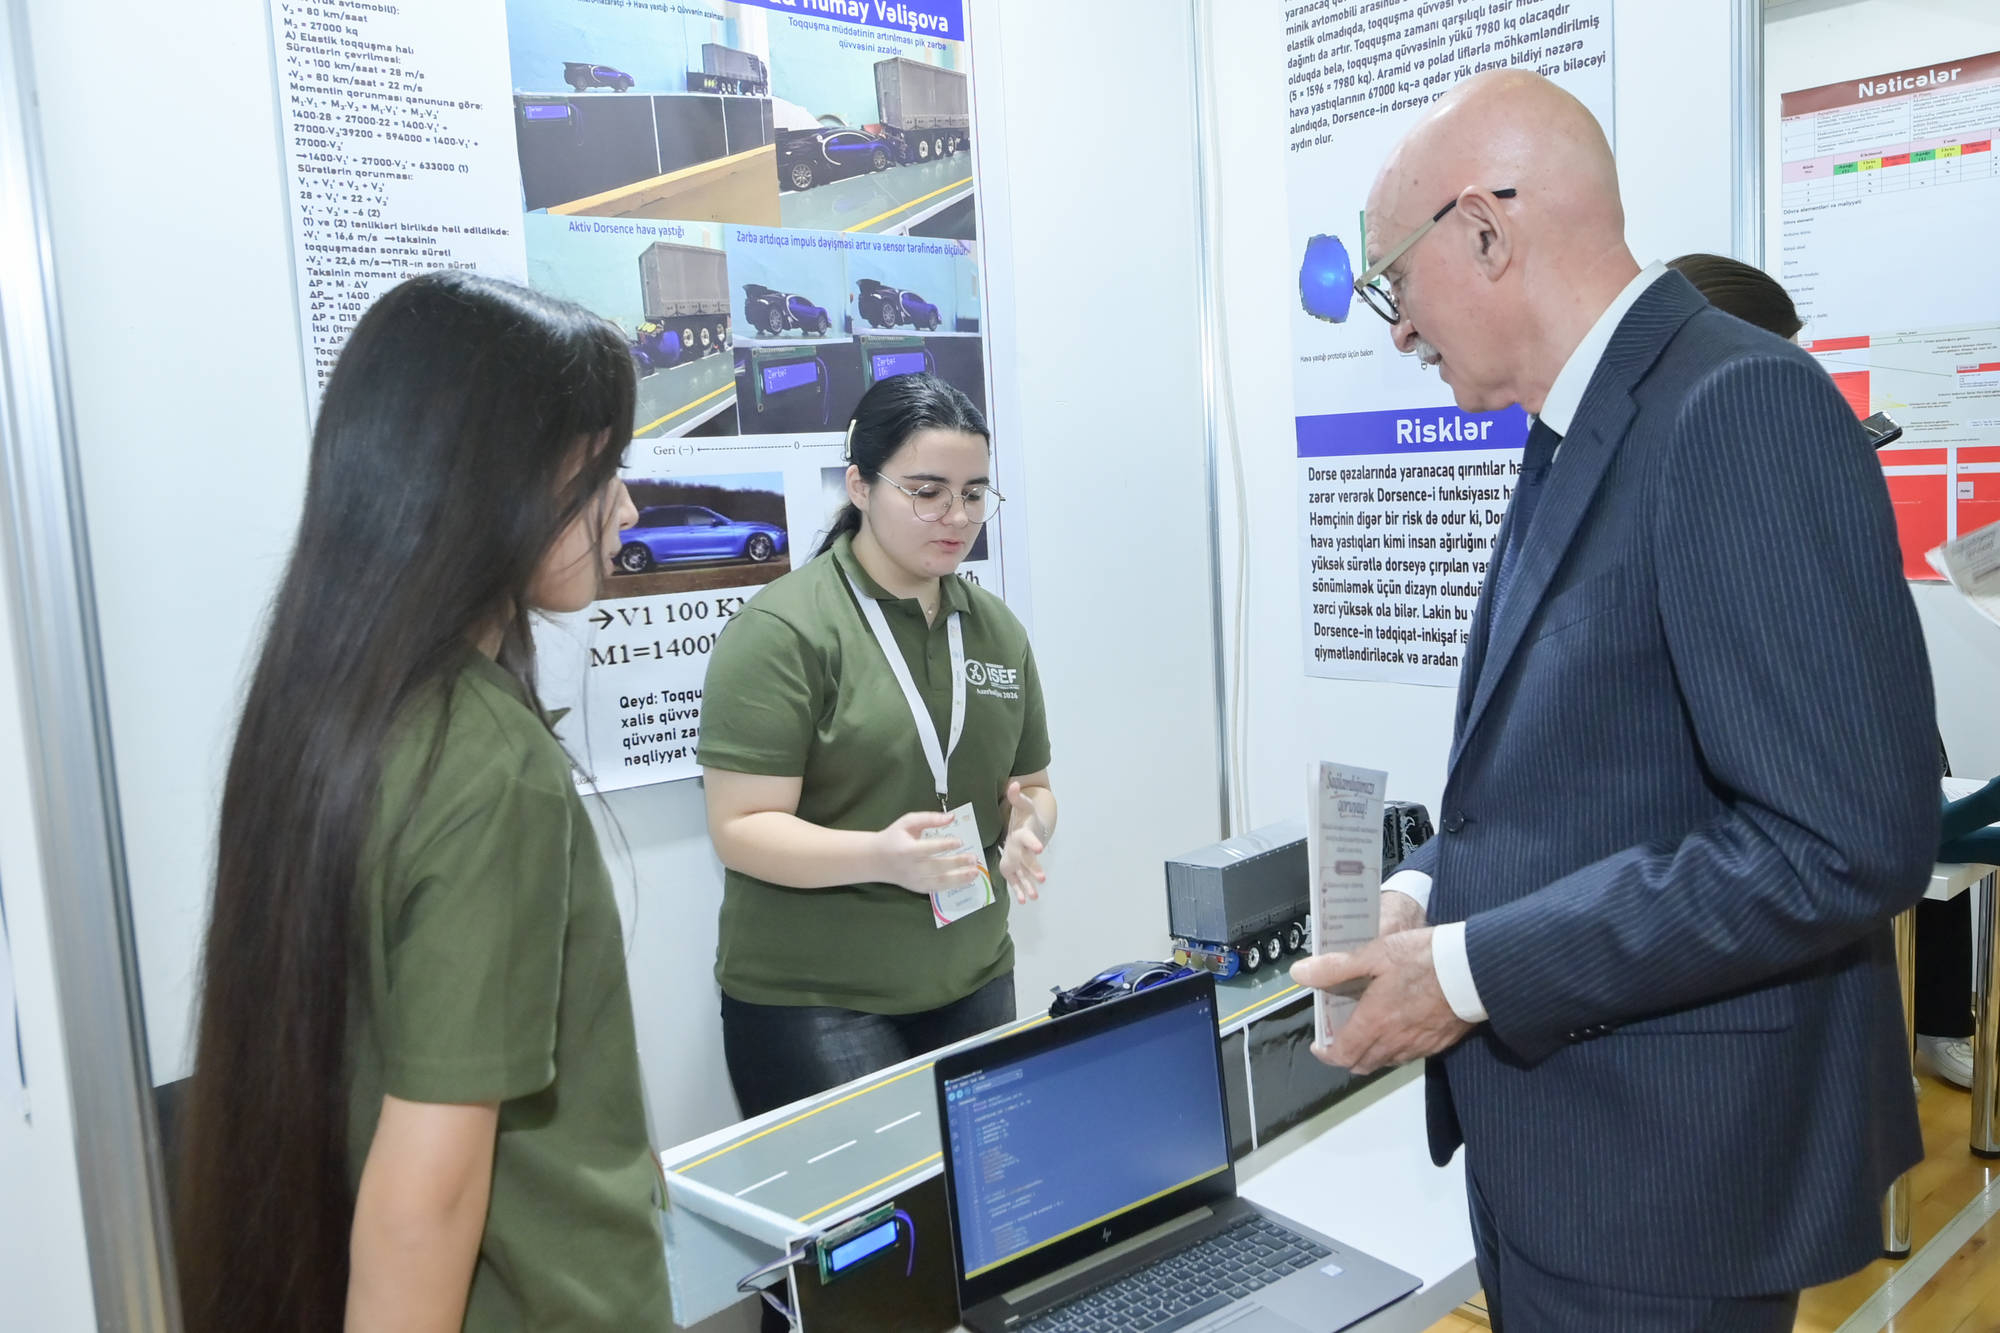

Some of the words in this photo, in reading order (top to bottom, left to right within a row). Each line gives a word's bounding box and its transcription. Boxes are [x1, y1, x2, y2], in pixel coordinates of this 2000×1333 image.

[873, 0, 948, 32] Vəlişova
[1286, 20, 1309, 36] minik
[1312, 5, 1357, 28] avtomobili
[1287, 35, 1315, 52] elastik
[1317, 22, 1366, 43] olmadıqda,
[1368, 9, 1414, 29] toqquşma
[1288, 53, 1315, 69] dağıntı
[1318, 49, 1328, 60] da
[1331, 44, 1352, 56] artır.
[1354, 31, 1401, 50] Toqquşma
[1404, 20, 1438, 37] zamanı
[1442, 6, 1485, 30] qarşılıqlı
[1488, 0, 1512, 15] təsir
[1288, 68, 1321, 85] olduqda
[1324, 62, 1344, 76] belə,
[1347, 51, 1392, 70] toqquşma
[1395, 36, 1446, 60] qüvvəsinin
[1449, 29, 1472, 47] yükü
[1476, 20, 1500, 36] 7980
[1504, 18, 1516, 30] kq
[1519, 4, 1570, 25] olacaqdır
[1334, 75, 1355, 90] 7980
[1358, 70, 1374, 85] kq).
[1377, 61, 1411, 80] Aramid
[1414, 60, 1424, 70] və
[1428, 50, 1454, 70] polad
[1564, 51, 1606, 72] biləcəyi
[1290, 106, 1309, 118] hava
[1311, 93, 1365, 116] yastıqlarının
[1368, 82, 1395, 99] 67000
[1398, 80, 1420, 93] kq-a
[1423, 72, 1451, 88] qədər
[1454, 64, 1472, 82] yük
[1511, 47, 1542, 65] bildiyi
[1546, 40, 1583, 57] nəzərə
[1858, 67, 1962, 99] Nəticələr
[1290, 117, 1330, 135] alındıqda,
[1332, 103, 1388, 124] Dorsence-in
[1392, 96, 1428, 111] dorseyə
[1291, 138, 1312, 153] aydın
[1315, 134, 1333, 145] olur.
[873, 242, 882, 251] və
[1396, 418, 1494, 444] Risklər
[654, 446, 676, 455] Geri
[1308, 467, 1337, 481] Dorse
[1340, 464, 1396, 483] qəzalarında
[1400, 466, 1454, 482] yaranacaq
[1458, 460, 1506, 480] qırıntılar
[1309, 492, 1335, 503] zərər
[1338, 488, 1374, 503] verərək
[1378, 486, 1435, 502] Dorsence-i
[1439, 485, 1500, 504] funksiyasız
[1310, 511, 1354, 529] Həmçinin
[1357, 511, 1382, 529] digər
[1385, 511, 1399, 525] bir
[1402, 510, 1422, 525] risk
[1426, 510, 1438, 525] də
[1442, 510, 1466, 525] odur
[1470, 510, 1482, 527] ki,
[1310, 534, 1333, 548] hava
[1336, 534, 1380, 552] yastıqları
[1384, 534, 1405, 548] kimi
[1408, 534, 1436, 548] insan
[1440, 532, 1486, 553] ağırlığını
[1312, 556, 1344, 574] yüksək
[1347, 556, 1382, 571] sürətlə
[1385, 557, 1426, 576] dorseyə
[1429, 558, 1469, 576] çırpılan
[1312, 578, 1374, 594] sönümləmək
[1377, 579, 1401, 598] üçün
[1405, 580, 1437, 599] dizayn
[618, 606, 653, 626] V1
[666, 601, 708, 623] 100
[1313, 601, 1336, 614] xərci
[1338, 601, 1373, 619] yüksək
[1376, 602, 1391, 617] ola
[1394, 603, 1419, 618] bilər.
[1422, 604, 1451, 619] Lakin
[1454, 606, 1468, 620] bu
[1314, 622, 1373, 639] Dorsence-in
[1376, 626, 1457, 646] tədqiqat-inkişaf
[1315, 645, 1404, 663] qiymətləndiriləcək
[1407, 653, 1418, 664] və
[1422, 652, 1458, 666] aradan
[987, 667, 1016, 684] ISEF
[620, 693, 658, 710] Qeyd:
[621, 713, 654, 728] xalis
[660, 707, 699, 726] qüvvə
[622, 728, 676, 750] qüvvəni
[624, 746, 687, 766] nəqliyyat
